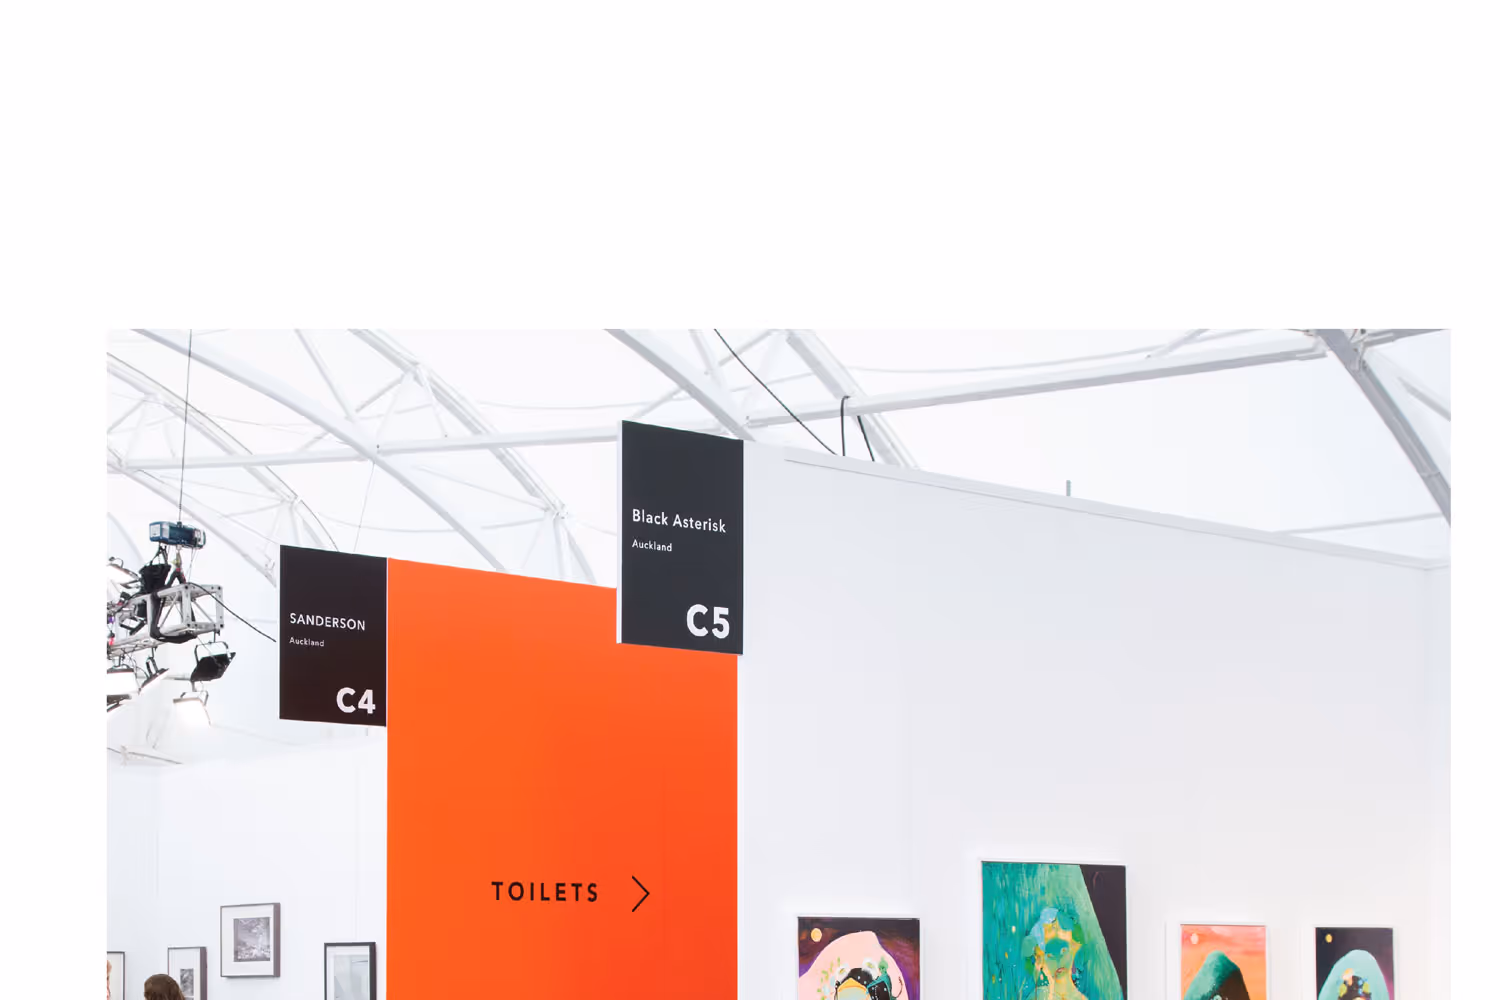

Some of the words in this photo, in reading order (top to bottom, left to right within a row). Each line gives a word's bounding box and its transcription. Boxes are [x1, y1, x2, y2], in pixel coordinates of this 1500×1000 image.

[632, 508, 669, 526] Black
[672, 514, 727, 534] Asterisk
[632, 538, 673, 552] Auckland
[289, 612, 366, 631] SANDERSON
[686, 603, 730, 639] C5
[289, 636, 325, 647] Auckland
[336, 687, 376, 714] C4
[491, 881, 599, 903] TOILETS
